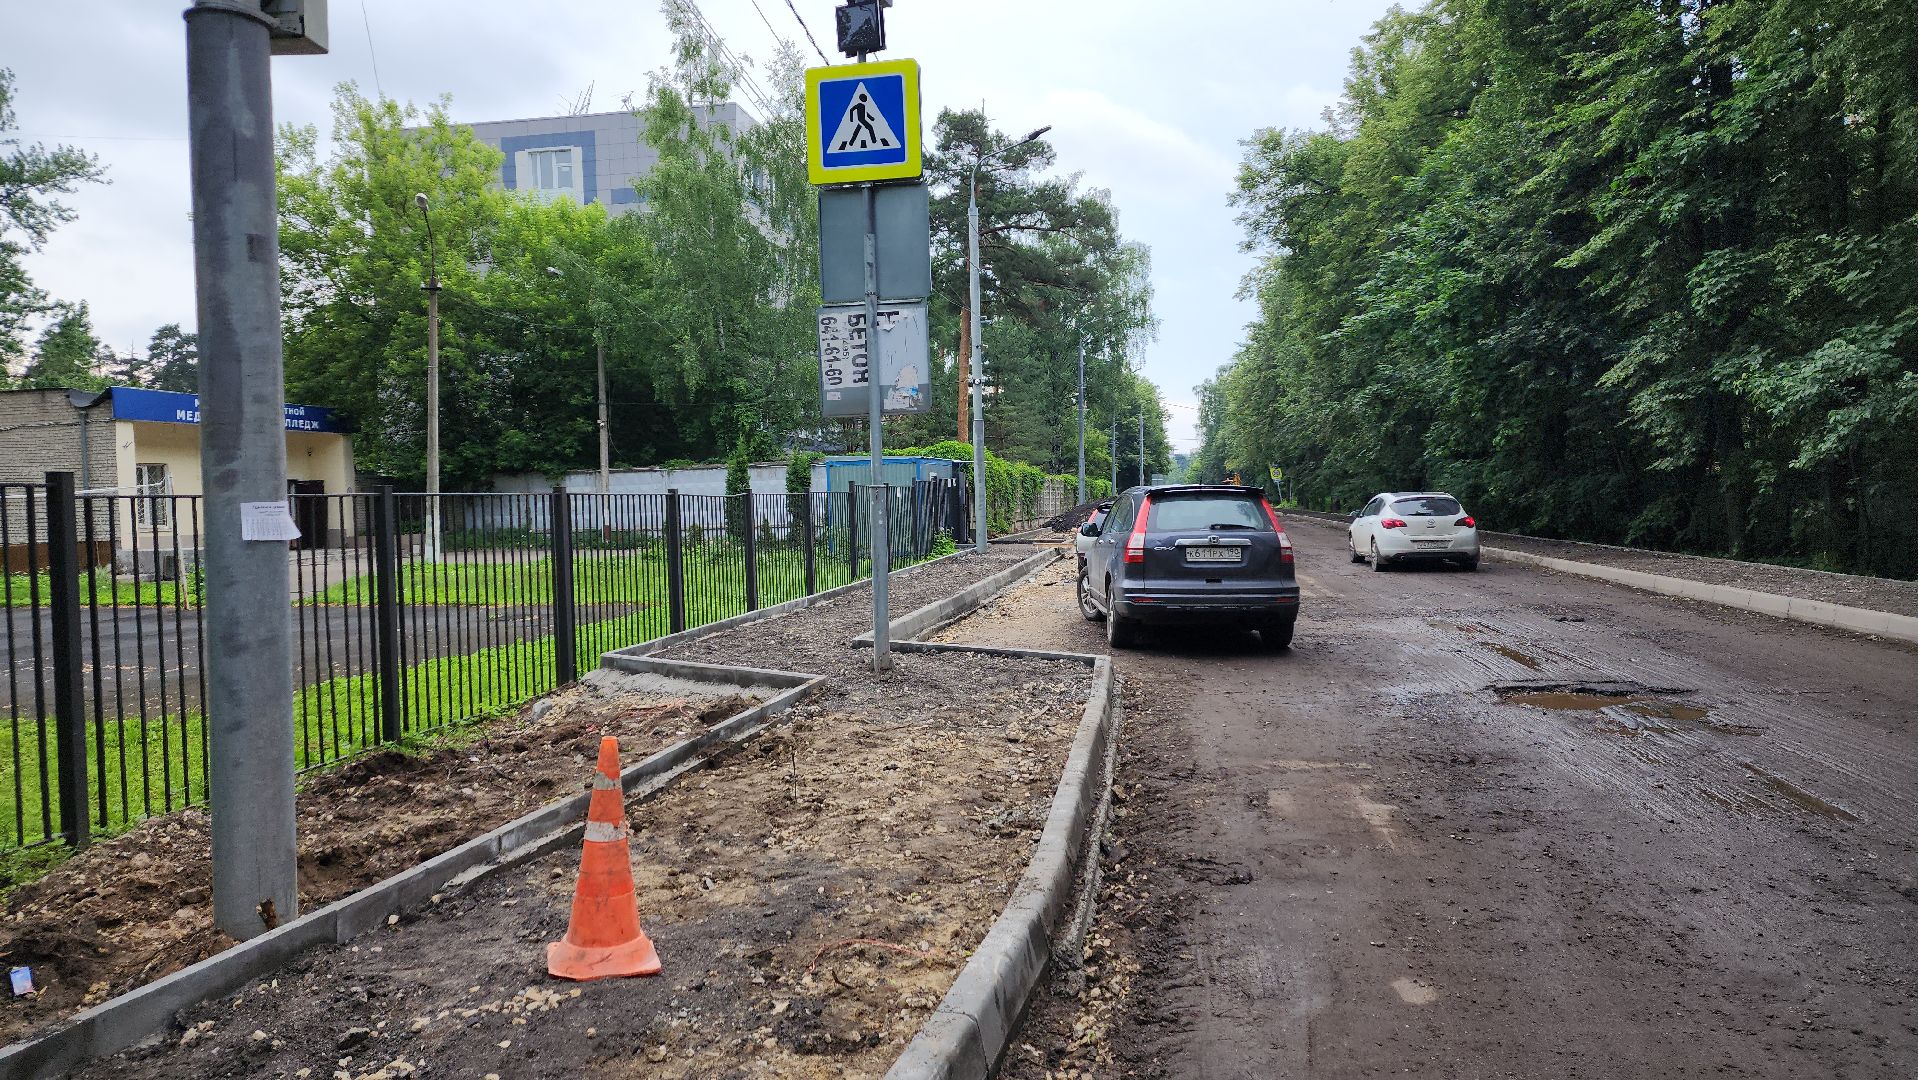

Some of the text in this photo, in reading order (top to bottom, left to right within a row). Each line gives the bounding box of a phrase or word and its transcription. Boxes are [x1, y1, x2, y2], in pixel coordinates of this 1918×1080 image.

[847, 313, 869, 384] БЕТОН
[176, 409, 319, 430] МЕД ЛЛЕДЖ
[284, 407, 304, 416] ТНОЙ
